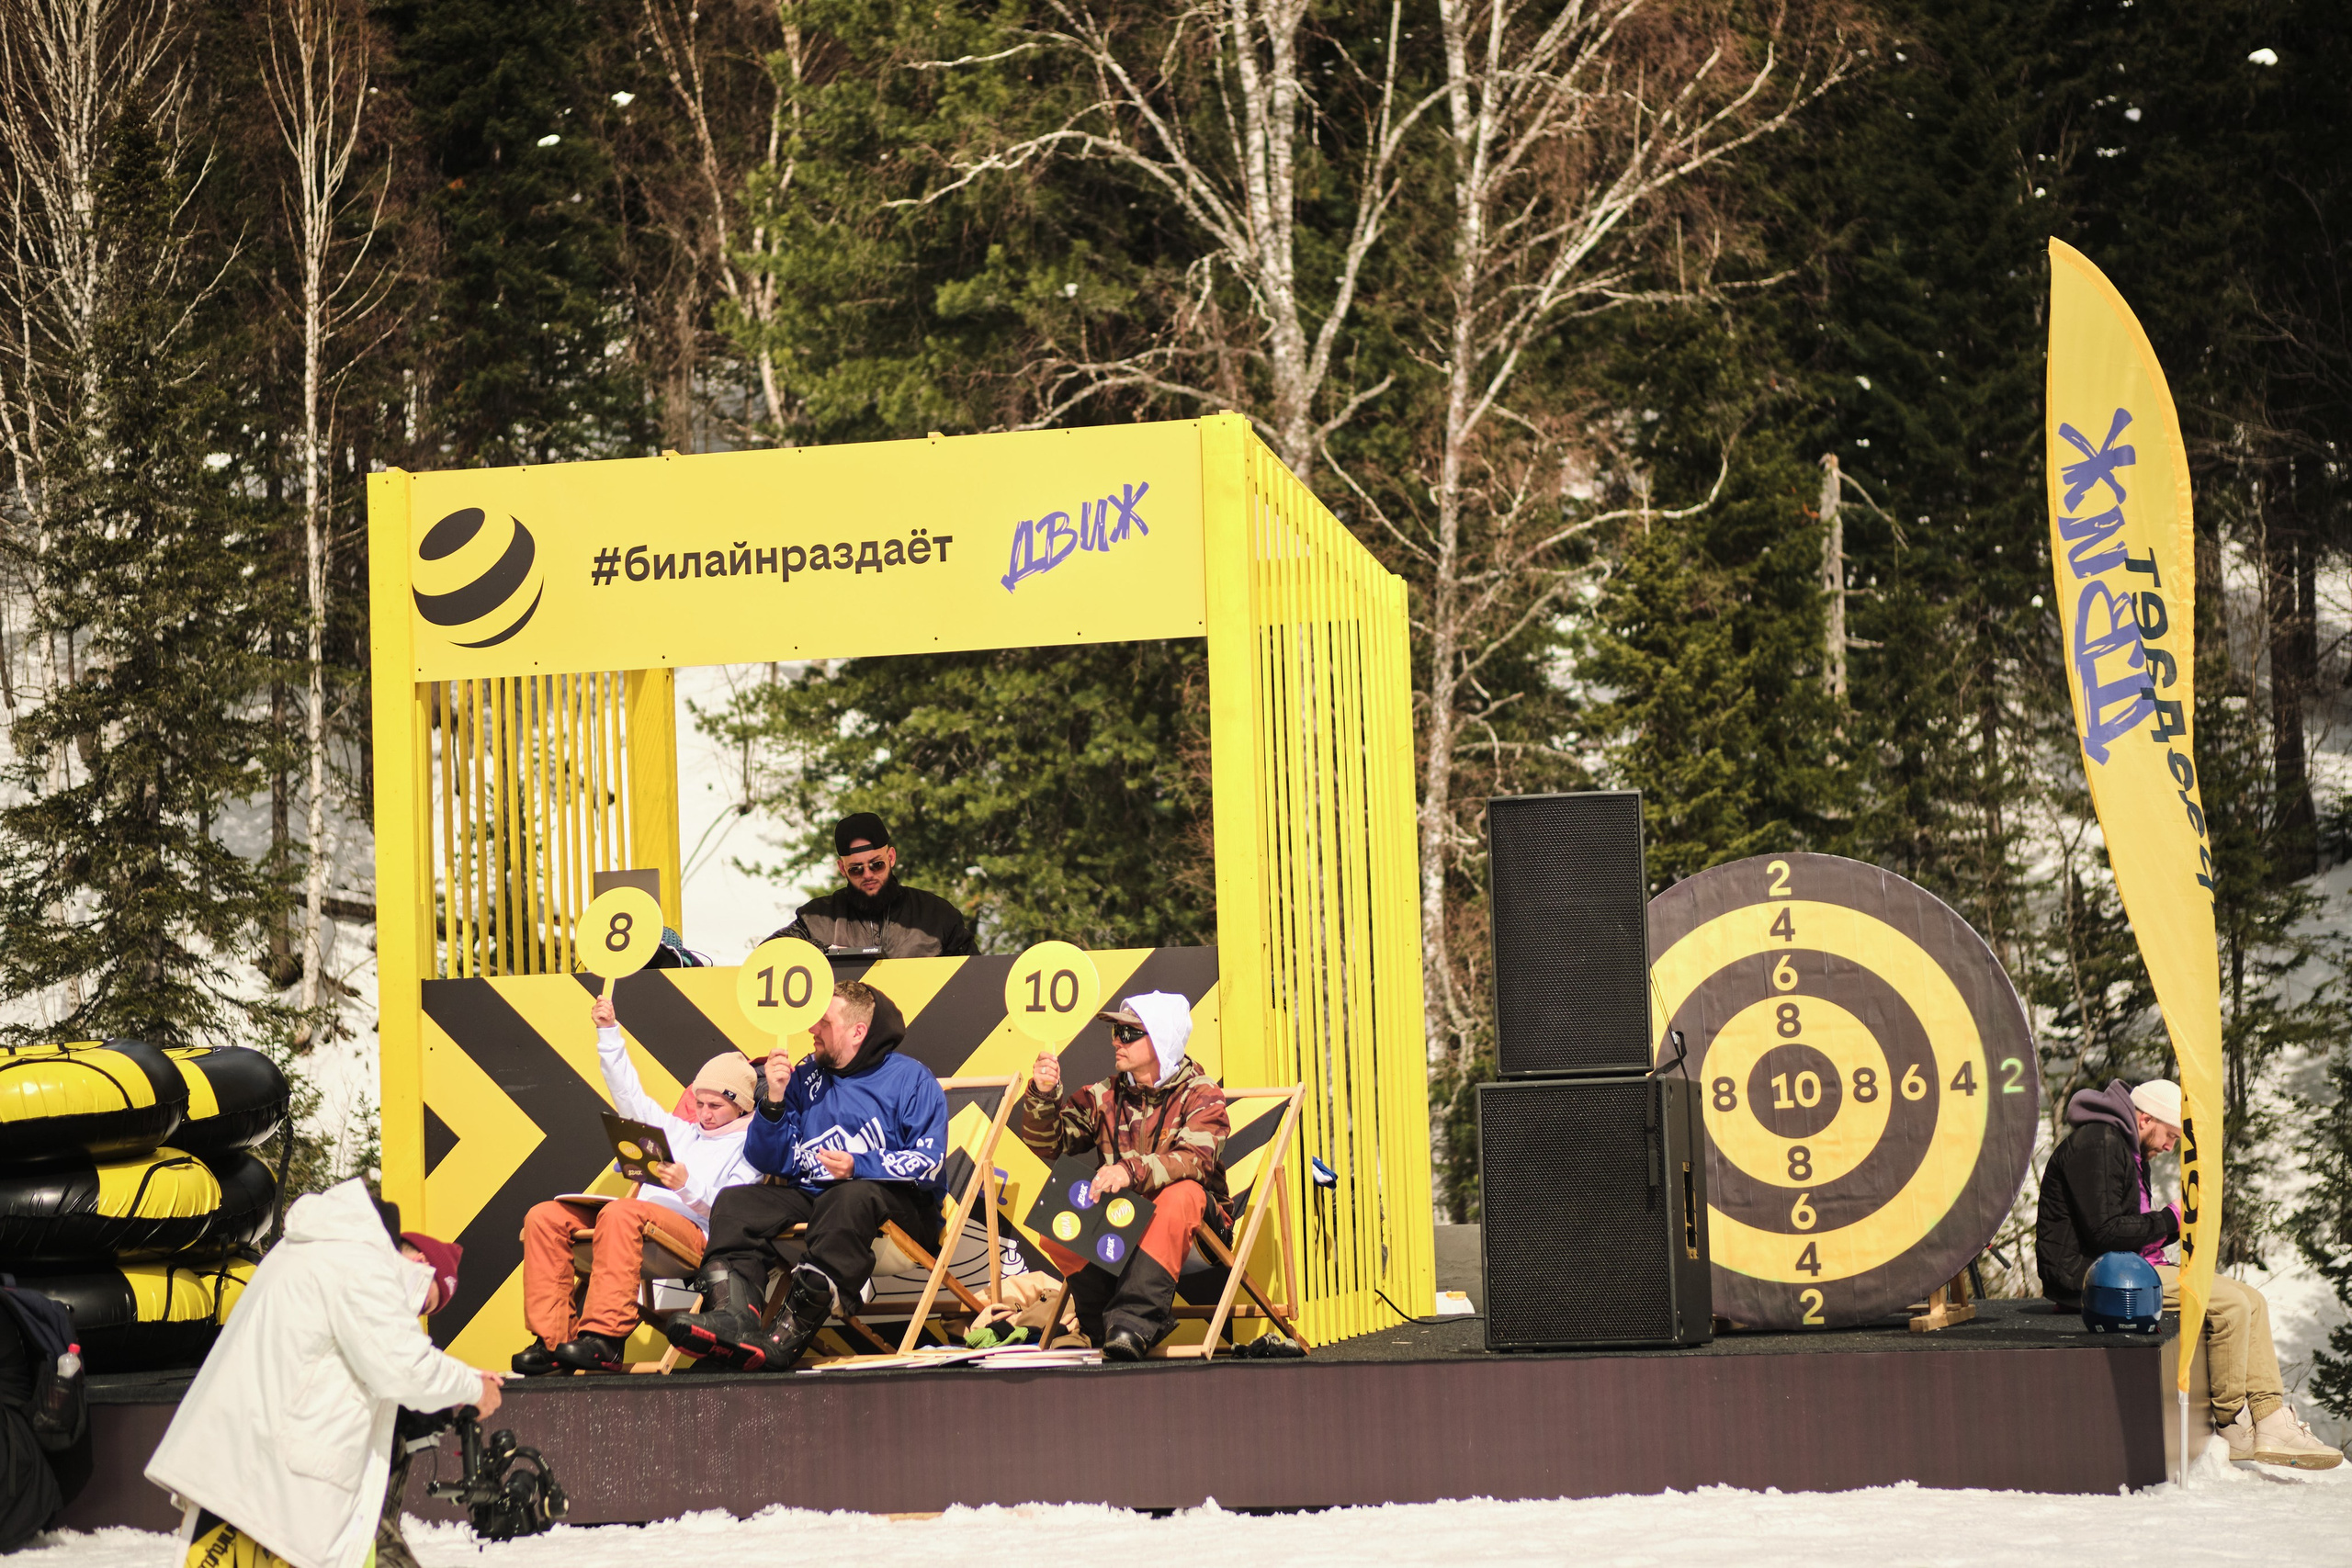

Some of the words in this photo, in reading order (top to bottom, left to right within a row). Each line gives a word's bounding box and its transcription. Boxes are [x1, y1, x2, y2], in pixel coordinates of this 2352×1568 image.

[591, 529, 954, 586] #билайнраздаёт
[1001, 481, 1150, 593] ДВИЖ
[1767, 861, 1792, 897] 2
[605, 912, 633, 952] 8
[1770, 907, 1795, 942] 4
[756, 965, 813, 1009] 10
[1024, 969, 1079, 1012] 10
[1773, 954, 1798, 991] 6
[1776, 1002, 1802, 1038] 8
[1712, 1077, 1737, 1112] 8
[1771, 1071, 1822, 1109] 10
[1852, 1066, 1879, 1103] 8
[1901, 1064, 1927, 1100] 6
[1950, 1061, 1977, 1097] 4
[2000, 1058, 2024, 1093] 2
[1787, 1145, 1812, 1181] 8
[1791, 1192, 1817, 1230] 6
[1795, 1241, 1822, 1277] 4
[1800, 1289, 1825, 1325] 2
